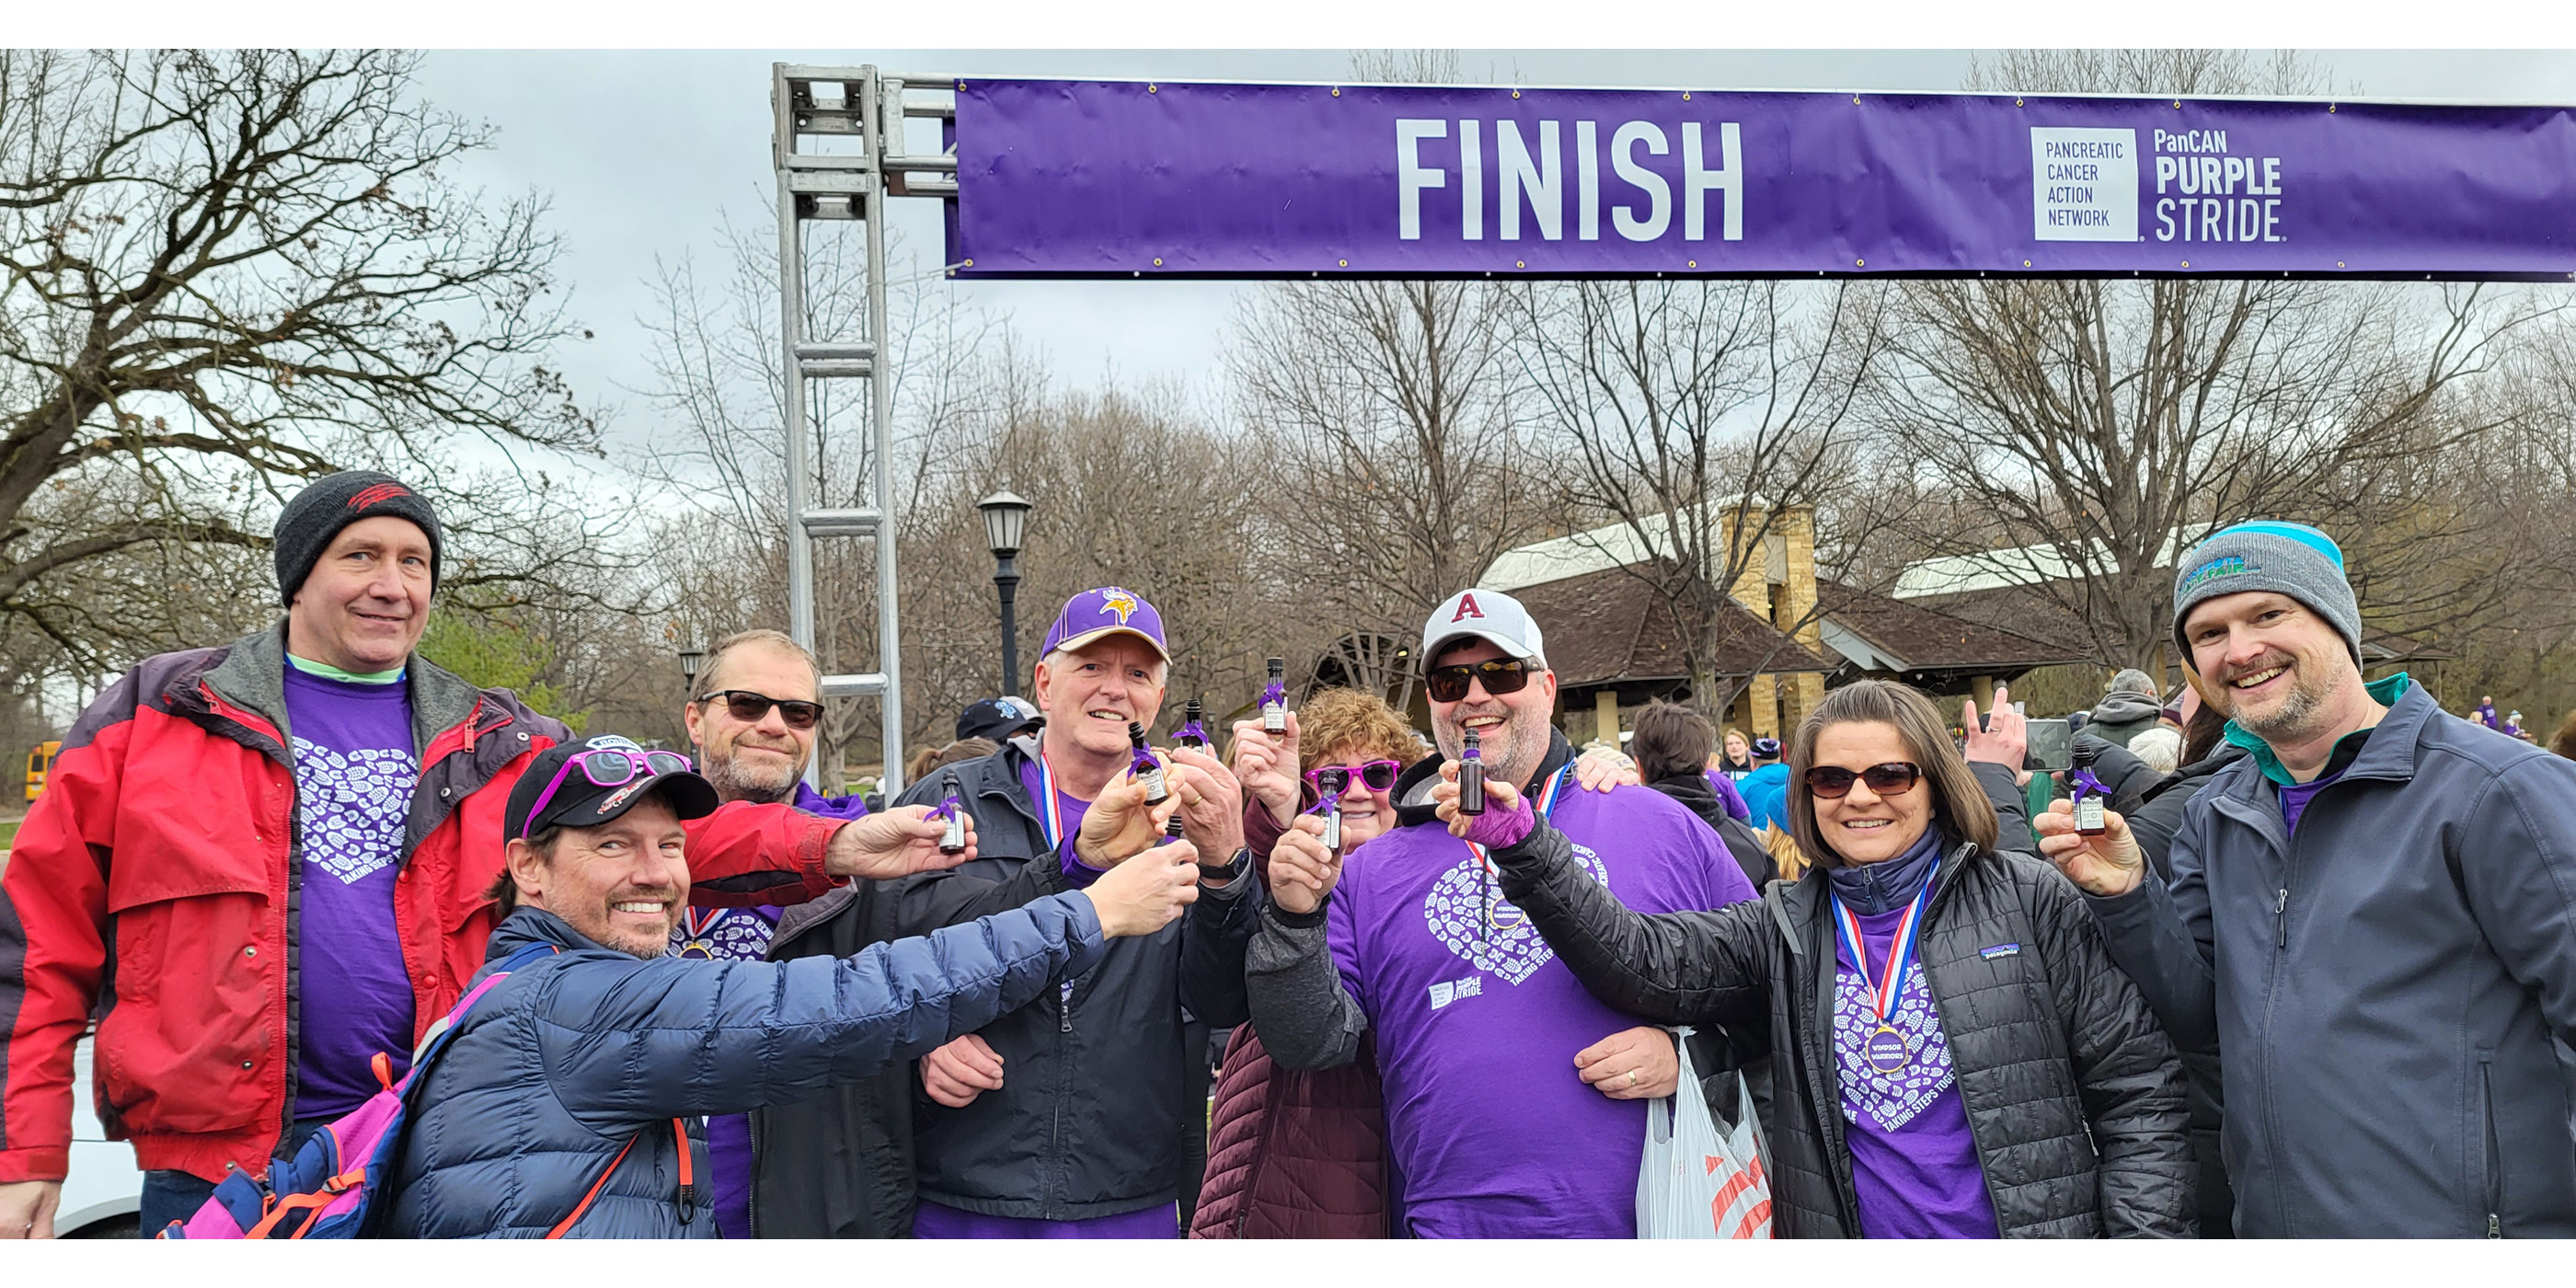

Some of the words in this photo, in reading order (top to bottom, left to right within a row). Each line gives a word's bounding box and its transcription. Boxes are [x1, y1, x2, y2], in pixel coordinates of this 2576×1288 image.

[2045, 142, 2123, 159] PANCREATIC
[2154, 128, 2227, 154] PanCAN
[1395, 118, 1743, 242] FINISH
[2047, 164, 2099, 181] CANCER
[2155, 155, 2282, 196] PURPLE
[2047, 186, 2093, 204] ACTION
[2048, 209, 2110, 226] NETWORK
[1451, 592, 1486, 624] A
[339, 864, 374, 885] TAKING
[1592, 857, 1609, 889] CREATIC
[1510, 962, 1538, 987] TAKING
[1535, 948, 1555, 967] STEP
[1870, 1052, 1904, 1061] WARRIORS
[1871, 1043, 1902, 1052] WINDSOR
[1882, 1109, 1915, 1133] TAKING
[1911, 1088, 1939, 1114] STEPS
[1933, 1067, 1957, 1093] TOGE
